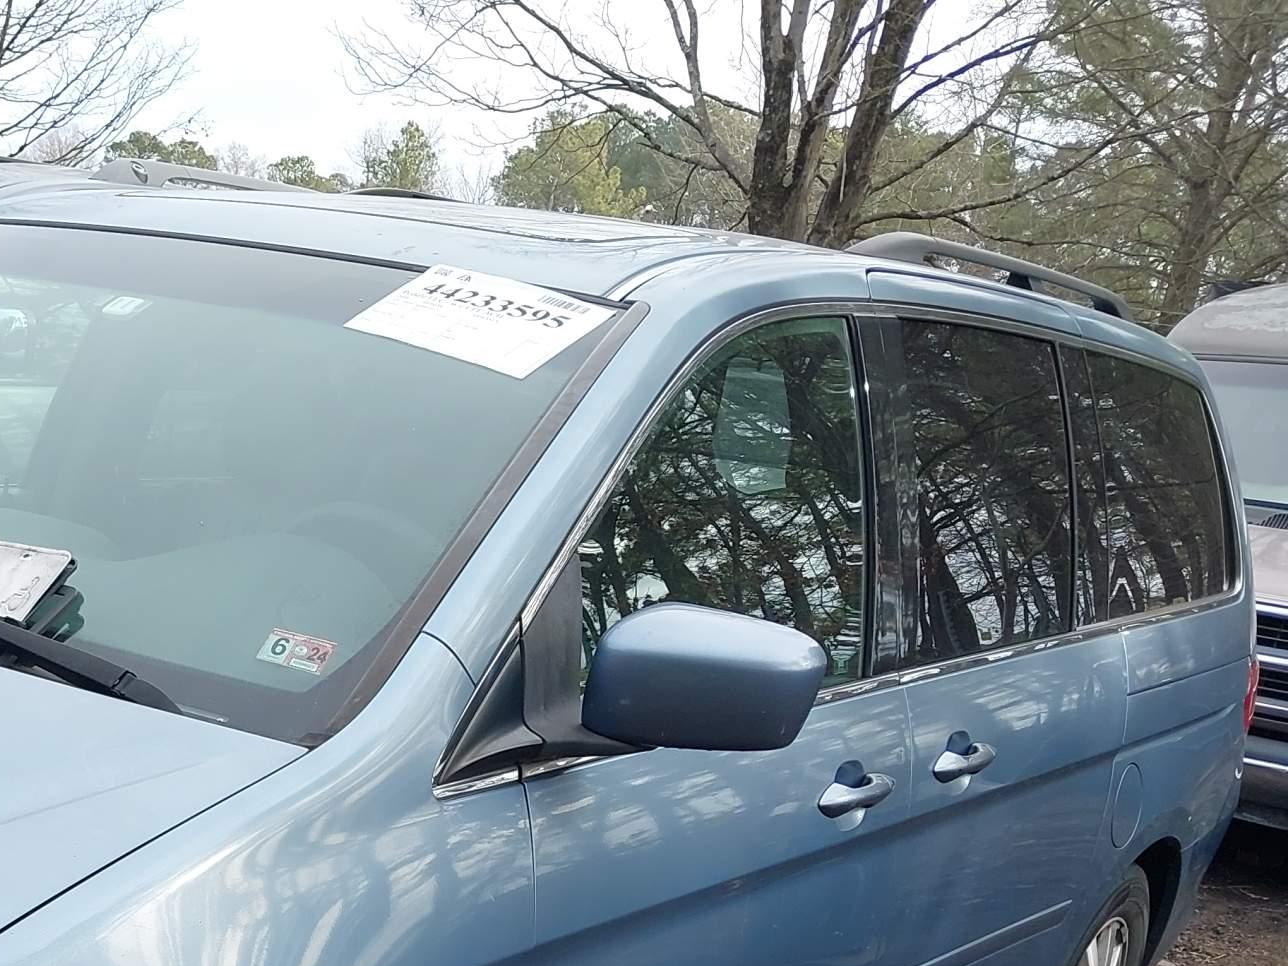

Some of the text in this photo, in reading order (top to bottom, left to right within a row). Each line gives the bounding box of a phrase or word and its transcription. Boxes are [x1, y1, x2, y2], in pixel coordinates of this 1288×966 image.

[423, 283, 571, 328] 44233595
[271, 638, 330, 664] 6 24
